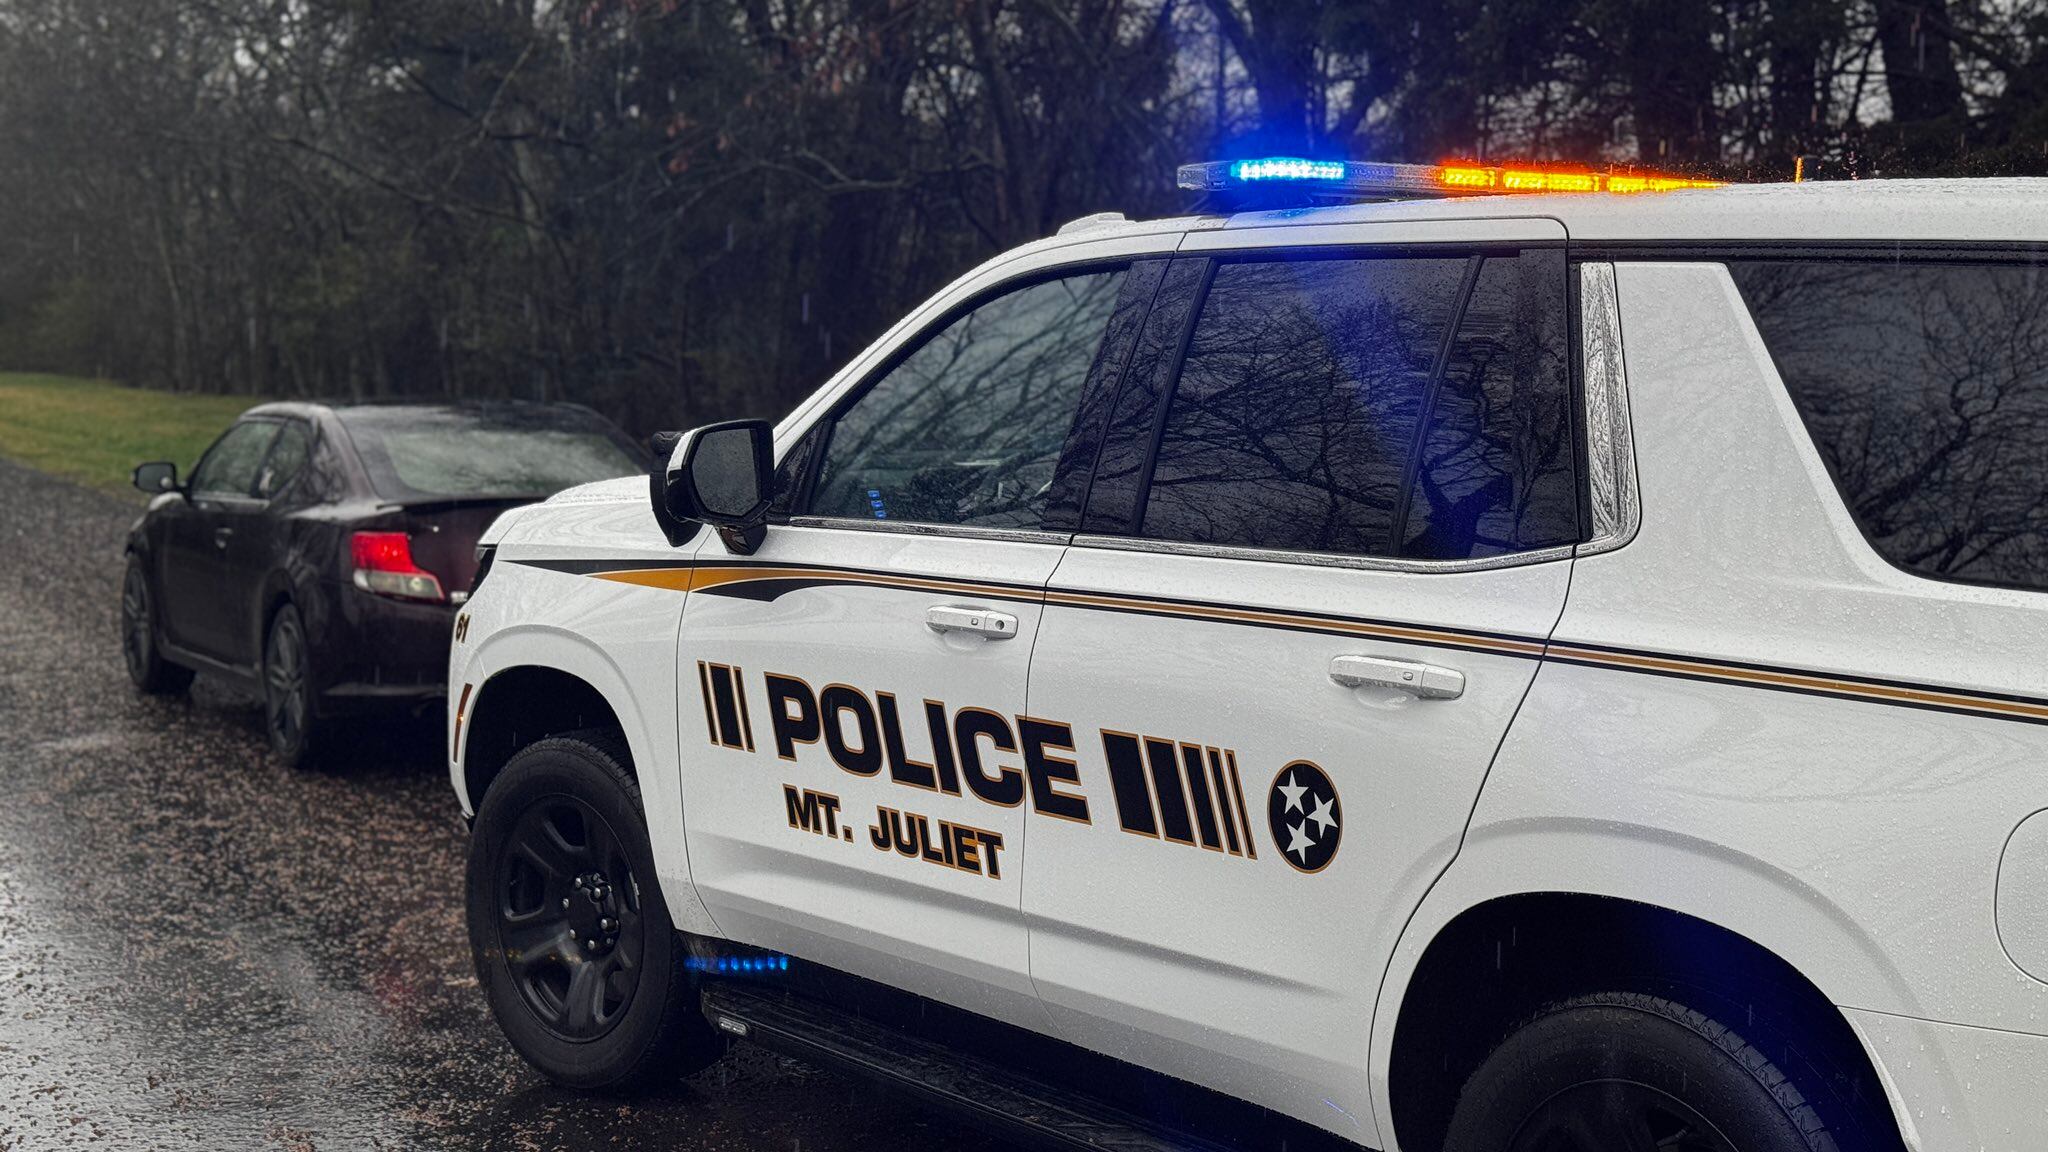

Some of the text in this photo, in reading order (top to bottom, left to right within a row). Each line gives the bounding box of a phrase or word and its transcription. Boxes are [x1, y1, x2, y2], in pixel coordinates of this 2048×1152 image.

[455, 612, 471, 644] 61
[764, 671, 1091, 825] POLICE
[782, 783, 1005, 880] MT. JULIET
